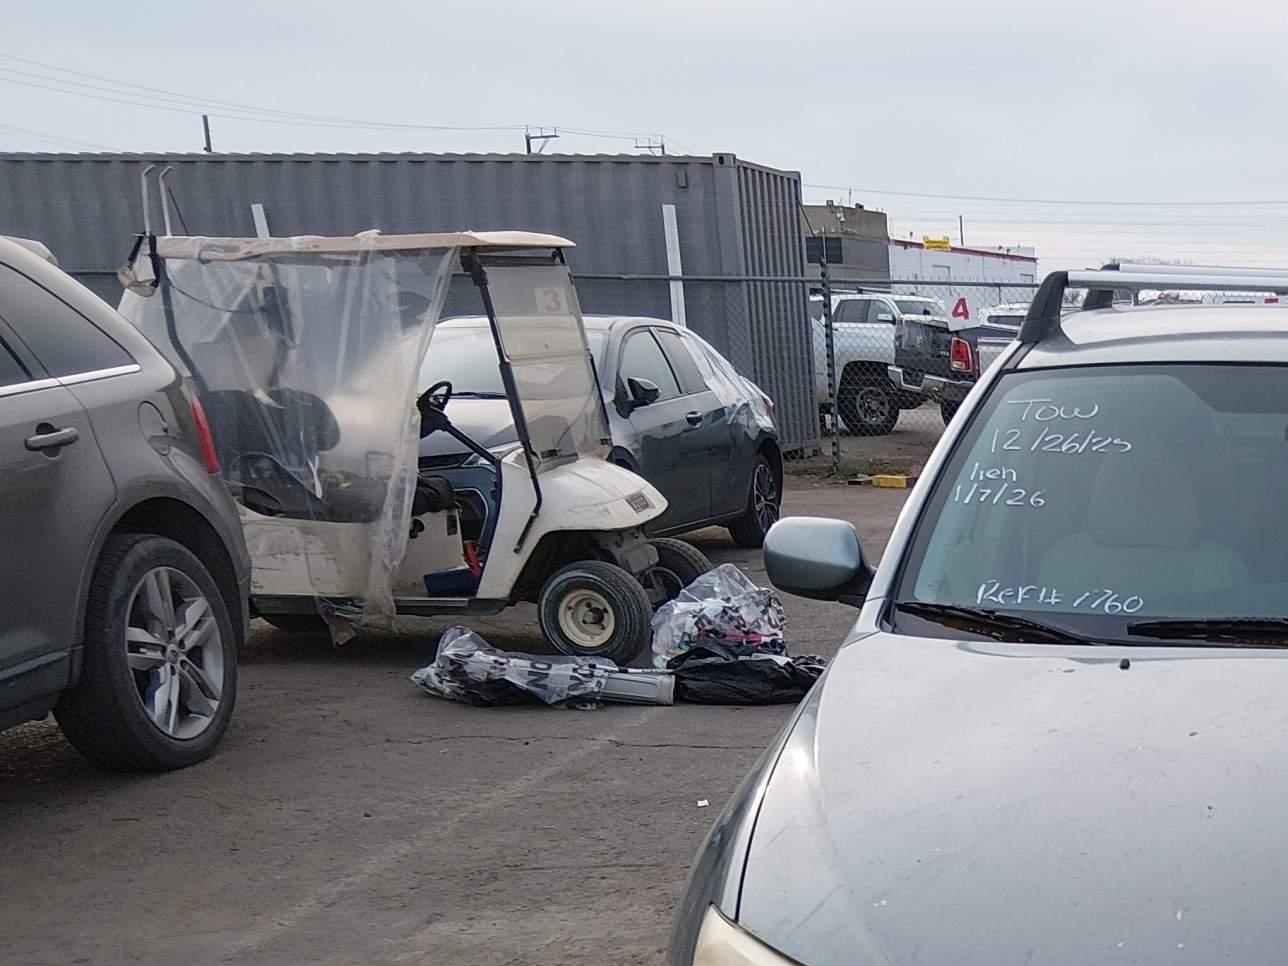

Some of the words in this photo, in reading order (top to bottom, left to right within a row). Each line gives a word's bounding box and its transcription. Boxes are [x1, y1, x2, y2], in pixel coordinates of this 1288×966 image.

[543, 289, 561, 312] 3
[952, 297, 969, 320] 4
[954, 483, 1045, 507] 1/7/26
